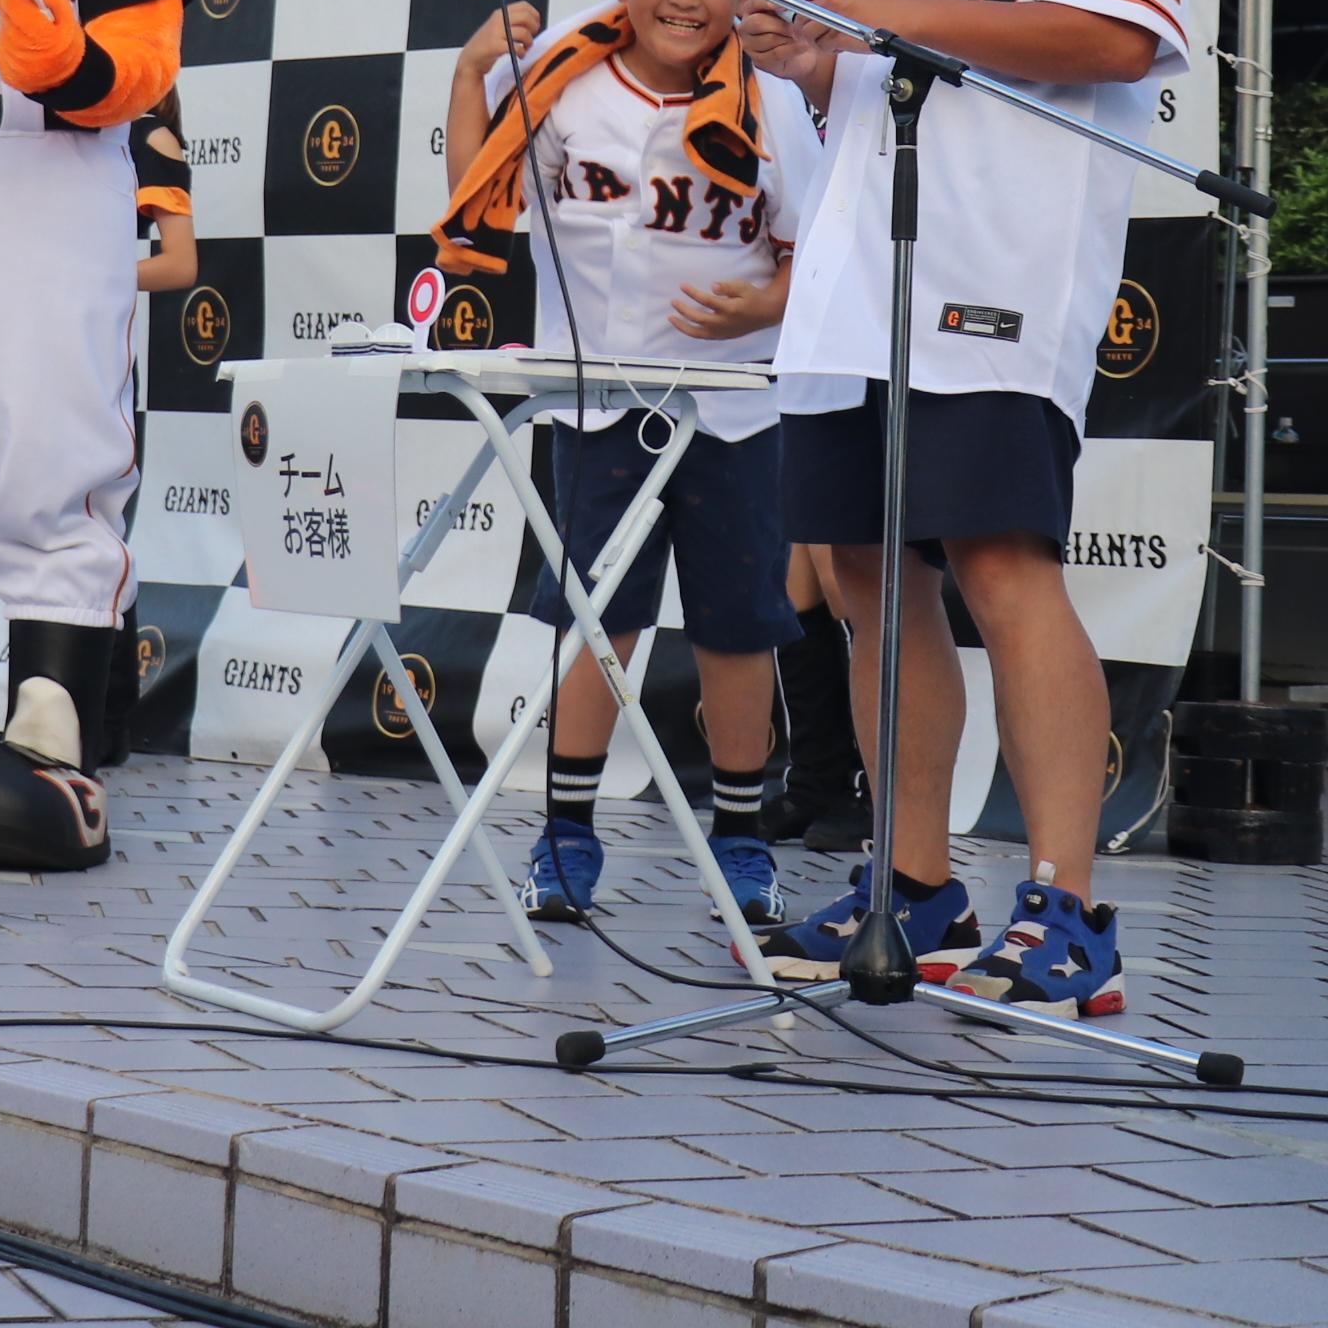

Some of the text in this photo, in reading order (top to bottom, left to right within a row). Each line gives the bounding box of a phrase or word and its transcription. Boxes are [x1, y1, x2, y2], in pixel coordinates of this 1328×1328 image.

[279, 453, 345, 498] チーム
[164, 485, 231, 516] GIANTS
[282, 506, 352, 560] お客様
[224, 658, 303, 695] GIANTS
